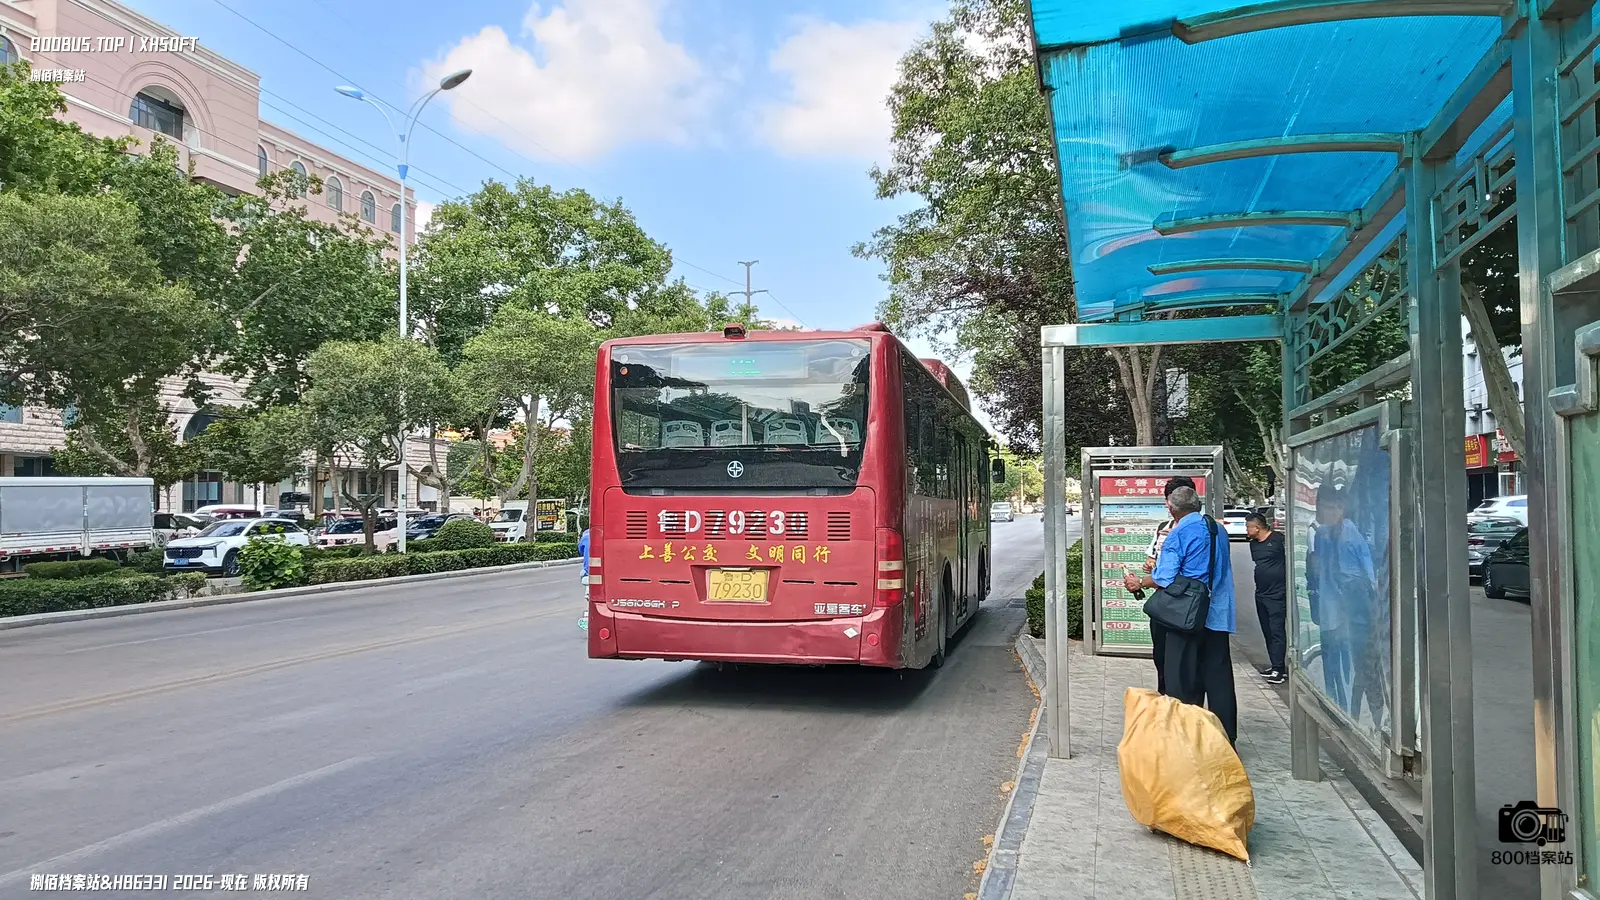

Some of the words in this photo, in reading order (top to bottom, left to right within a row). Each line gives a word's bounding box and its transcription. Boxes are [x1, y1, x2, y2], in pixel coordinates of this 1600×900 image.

[638, 541, 719, 563] 上善公交
[745, 543, 832, 565] 文明同行
[712, 582, 762, 599] 79230
[814, 602, 863, 616] 亚星客车
